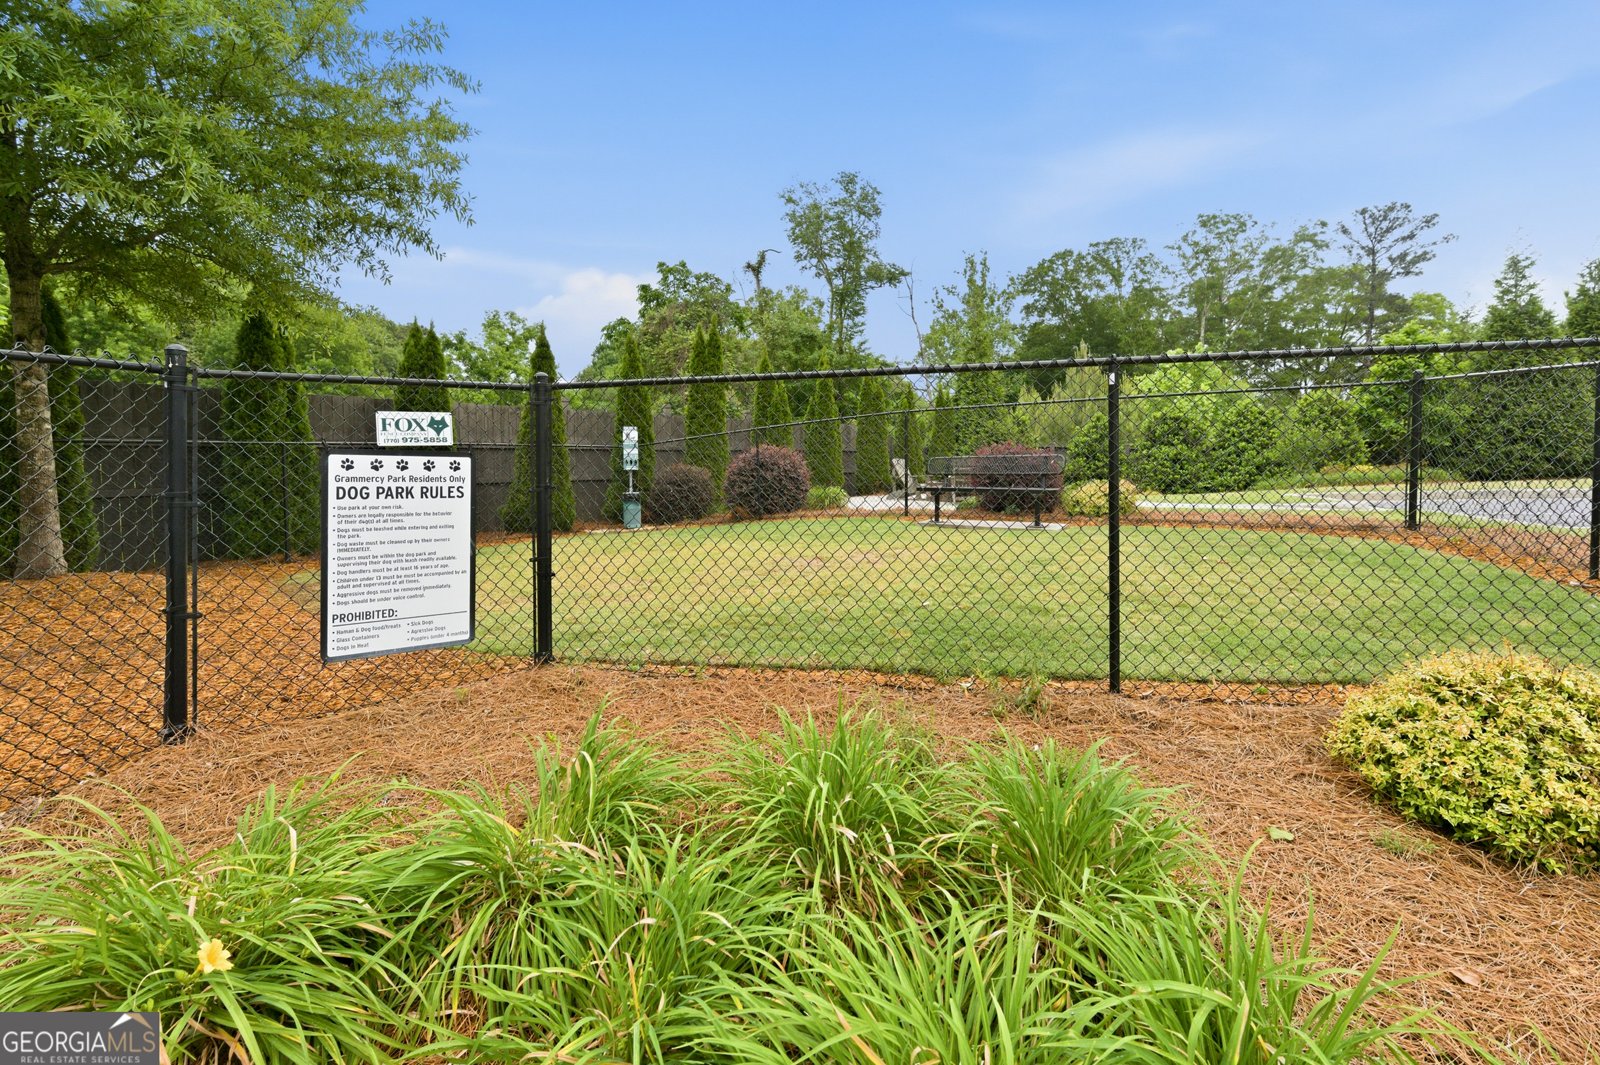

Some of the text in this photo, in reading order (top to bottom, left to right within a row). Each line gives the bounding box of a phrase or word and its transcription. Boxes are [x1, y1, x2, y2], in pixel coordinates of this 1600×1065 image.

[381, 418, 426, 432] FOX
[335, 475, 384, 484] Grammercy
[449, 476, 465, 484] Only
[336, 486, 464, 500] DOG PARK RULES
[332, 608, 398, 623] PROHIBITED:
